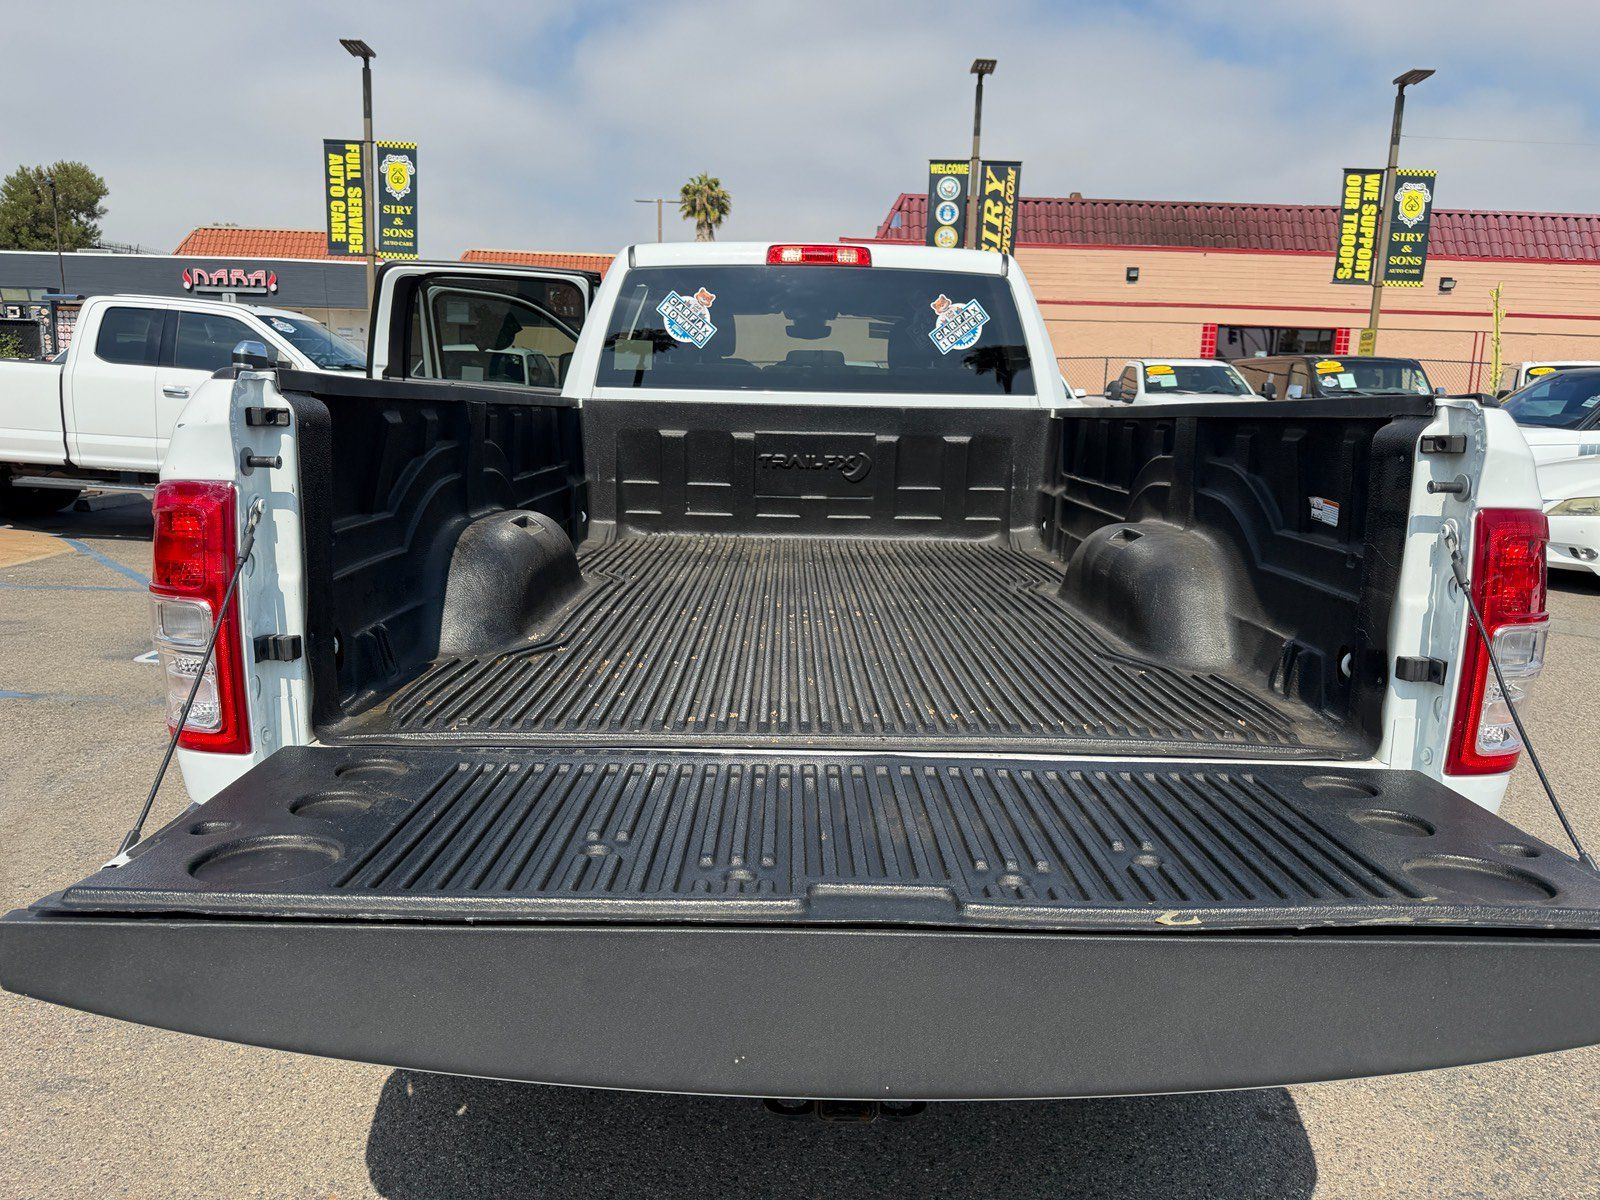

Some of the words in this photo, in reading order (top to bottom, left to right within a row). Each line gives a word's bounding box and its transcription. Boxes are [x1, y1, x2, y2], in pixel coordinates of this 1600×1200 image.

[328, 153, 346, 198] AUTO
[345, 143, 362, 180] FULL
[930, 163, 969, 175] WELCOME
[1344, 174, 1362, 210] OUR
[1363, 173, 1381, 201] WE
[330, 200, 347, 242] CARE
[347, 186, 364, 254] SERVICE
[383, 204, 413, 215] SIRY
[392, 217, 404, 226] &
[382, 228, 414, 238] SONS
[1336, 212, 1359, 280] TROOPS
[1354, 203, 1378, 282] SUPPORT
[1391, 232, 1425, 243] SIRY
[1400, 244, 1413, 253] &
[1388, 255, 1423, 266] SONS
[192, 268, 267, 286] NARA
[669, 297, 710, 336] CARFAX
[669, 309, 705, 342] OWNER
[935, 307, 978, 340] CARFAX
[948, 312, 984, 343] OWNER
[758, 453, 863, 473] TRAILFX
